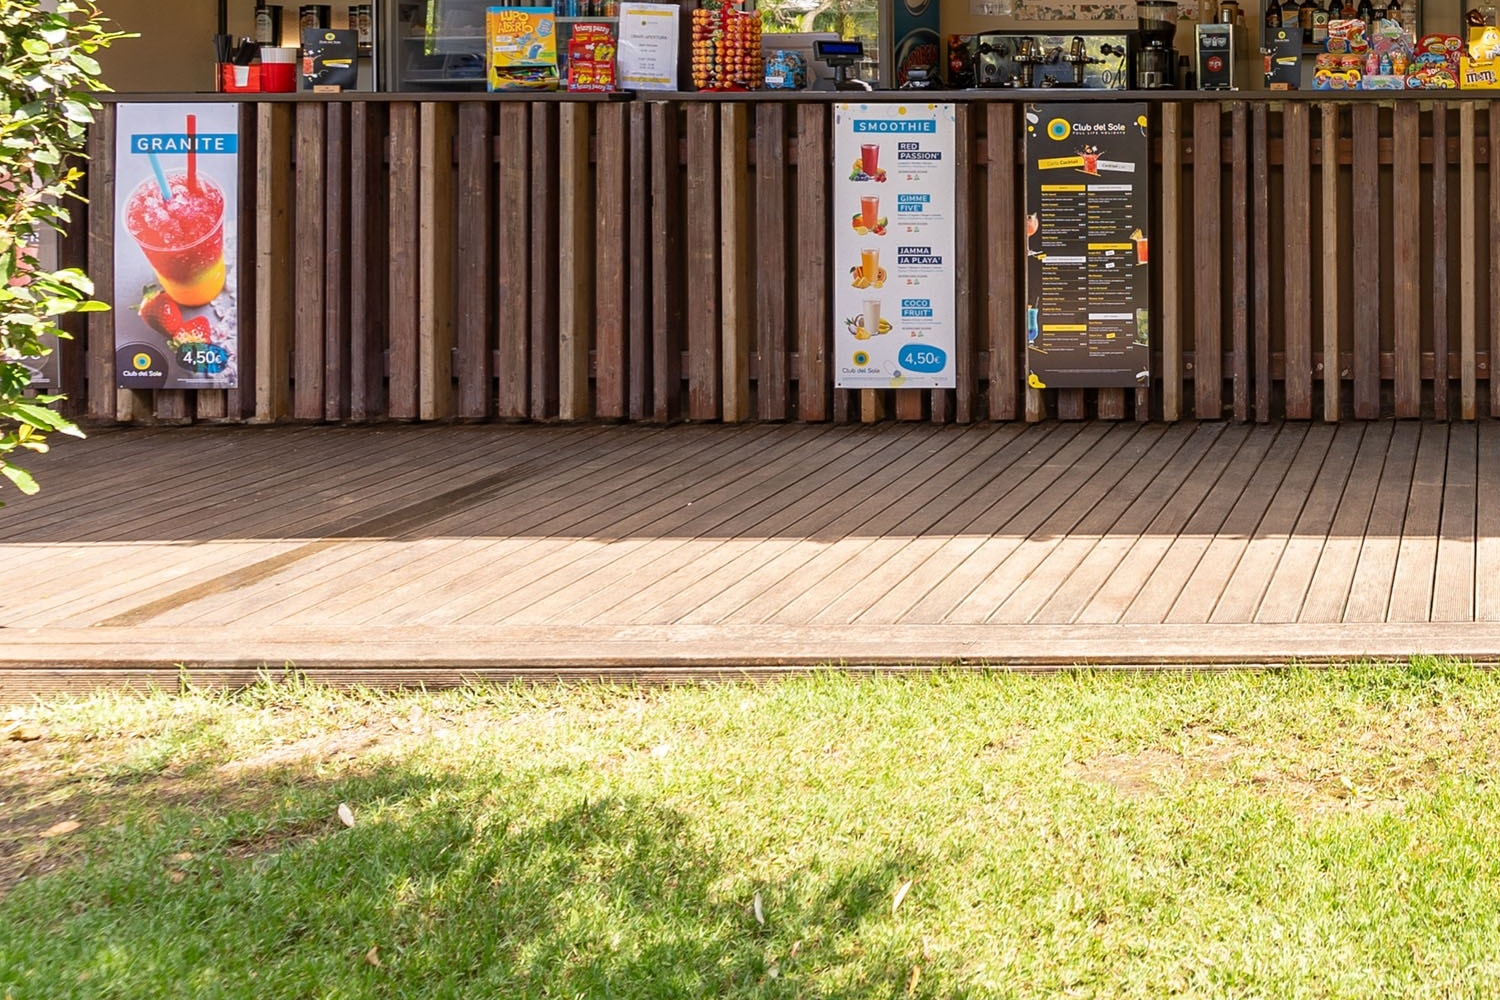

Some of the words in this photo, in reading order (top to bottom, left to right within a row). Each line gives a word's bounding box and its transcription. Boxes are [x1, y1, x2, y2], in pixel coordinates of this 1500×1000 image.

[501, 10, 529, 22] LUPO
[859, 122, 931, 132] SMOOTHIE
[1072, 123, 1092, 131] Club
[1093, 123, 1106, 131] del
[1108, 123, 1126, 131] Sole
[137, 137, 225, 151] GRANITE
[183, 350, 222, 365] 4,50€
[905, 352, 940, 366] 4,50€
[123, 369, 137, 377] Club
[138, 369, 148, 377] del
[149, 369, 162, 377] Sole
